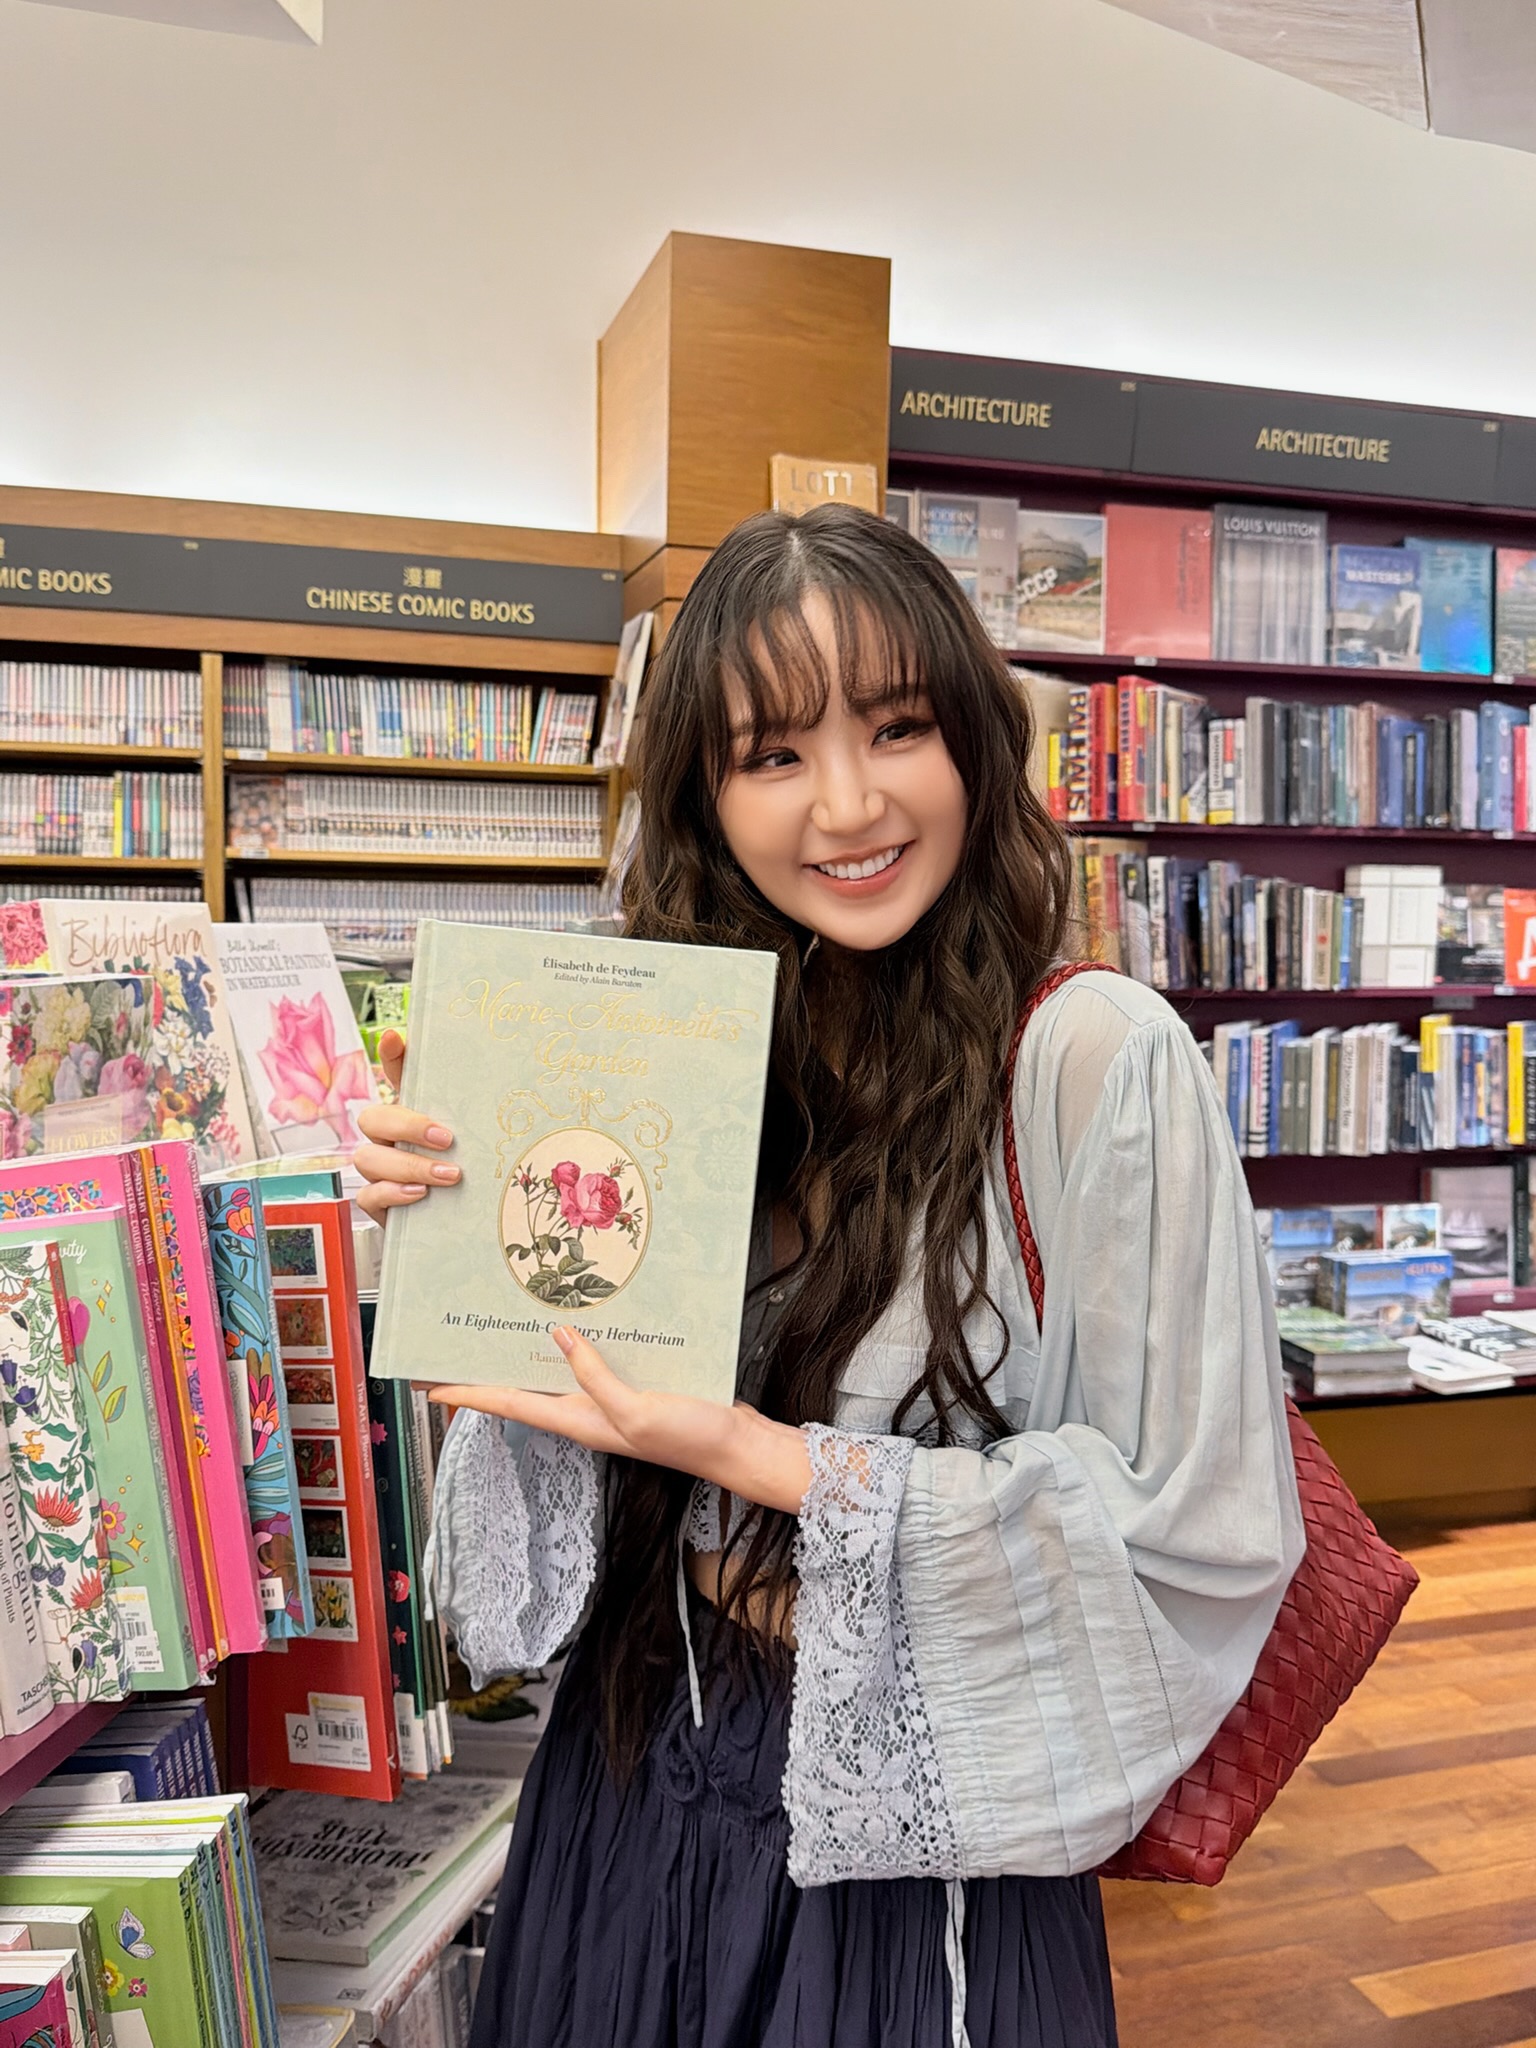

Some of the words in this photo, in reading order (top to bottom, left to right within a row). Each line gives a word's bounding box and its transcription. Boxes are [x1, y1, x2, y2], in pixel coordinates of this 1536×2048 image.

[900, 390, 1052, 428] ARCHITECTURE
[1255, 427, 1391, 463] ARCHITECTURE
[1224, 517, 1264, 533] LOUIS
[1265, 520, 1320, 537] VUITTON
[38, 568, 113, 595] BOOKS
[306, 586, 394, 614] CHINESE
[398, 594, 465, 620] COMIC
[470, 599, 535, 625] BOOKS
[61, 915, 208, 968] Biblioflora
[219, 955, 284, 974] BOTANICAL
[283, 953, 332, 971] PAINTING
[543, 956, 594, 973] Élisabeth
[596, 963, 609, 974] de
[612, 965, 656, 979] Feydeau
[554, 972, 579, 983] Edited
[580, 975, 589, 984] by
[590, 976, 610, 986] Alain
[612, 979, 642, 988] Baraton
[449, 979, 759, 1042] Marie-Antoinette's
[535, 1031, 649, 1087] Garden
[130, 1216, 144, 1266] COLORING
[197, 1202, 209, 1250] COLORING
[134, 1171, 147, 1214] MYSTERY
[141, 1218, 155, 1264] COLORING
[150, 1278, 162, 1322] Flowers
[441, 1312, 460, 1327] An
[606, 1326, 686, 1347] Herbarium
[357, 1382, 365, 1402] The
[358, 1404, 367, 1422] Art
[362, 1434, 371, 1479] Flowers
[0, 1470, 38, 1645] Florilegium
[0, 1571, 9, 1587] of
[4, 1586, 16, 1624] Plants
